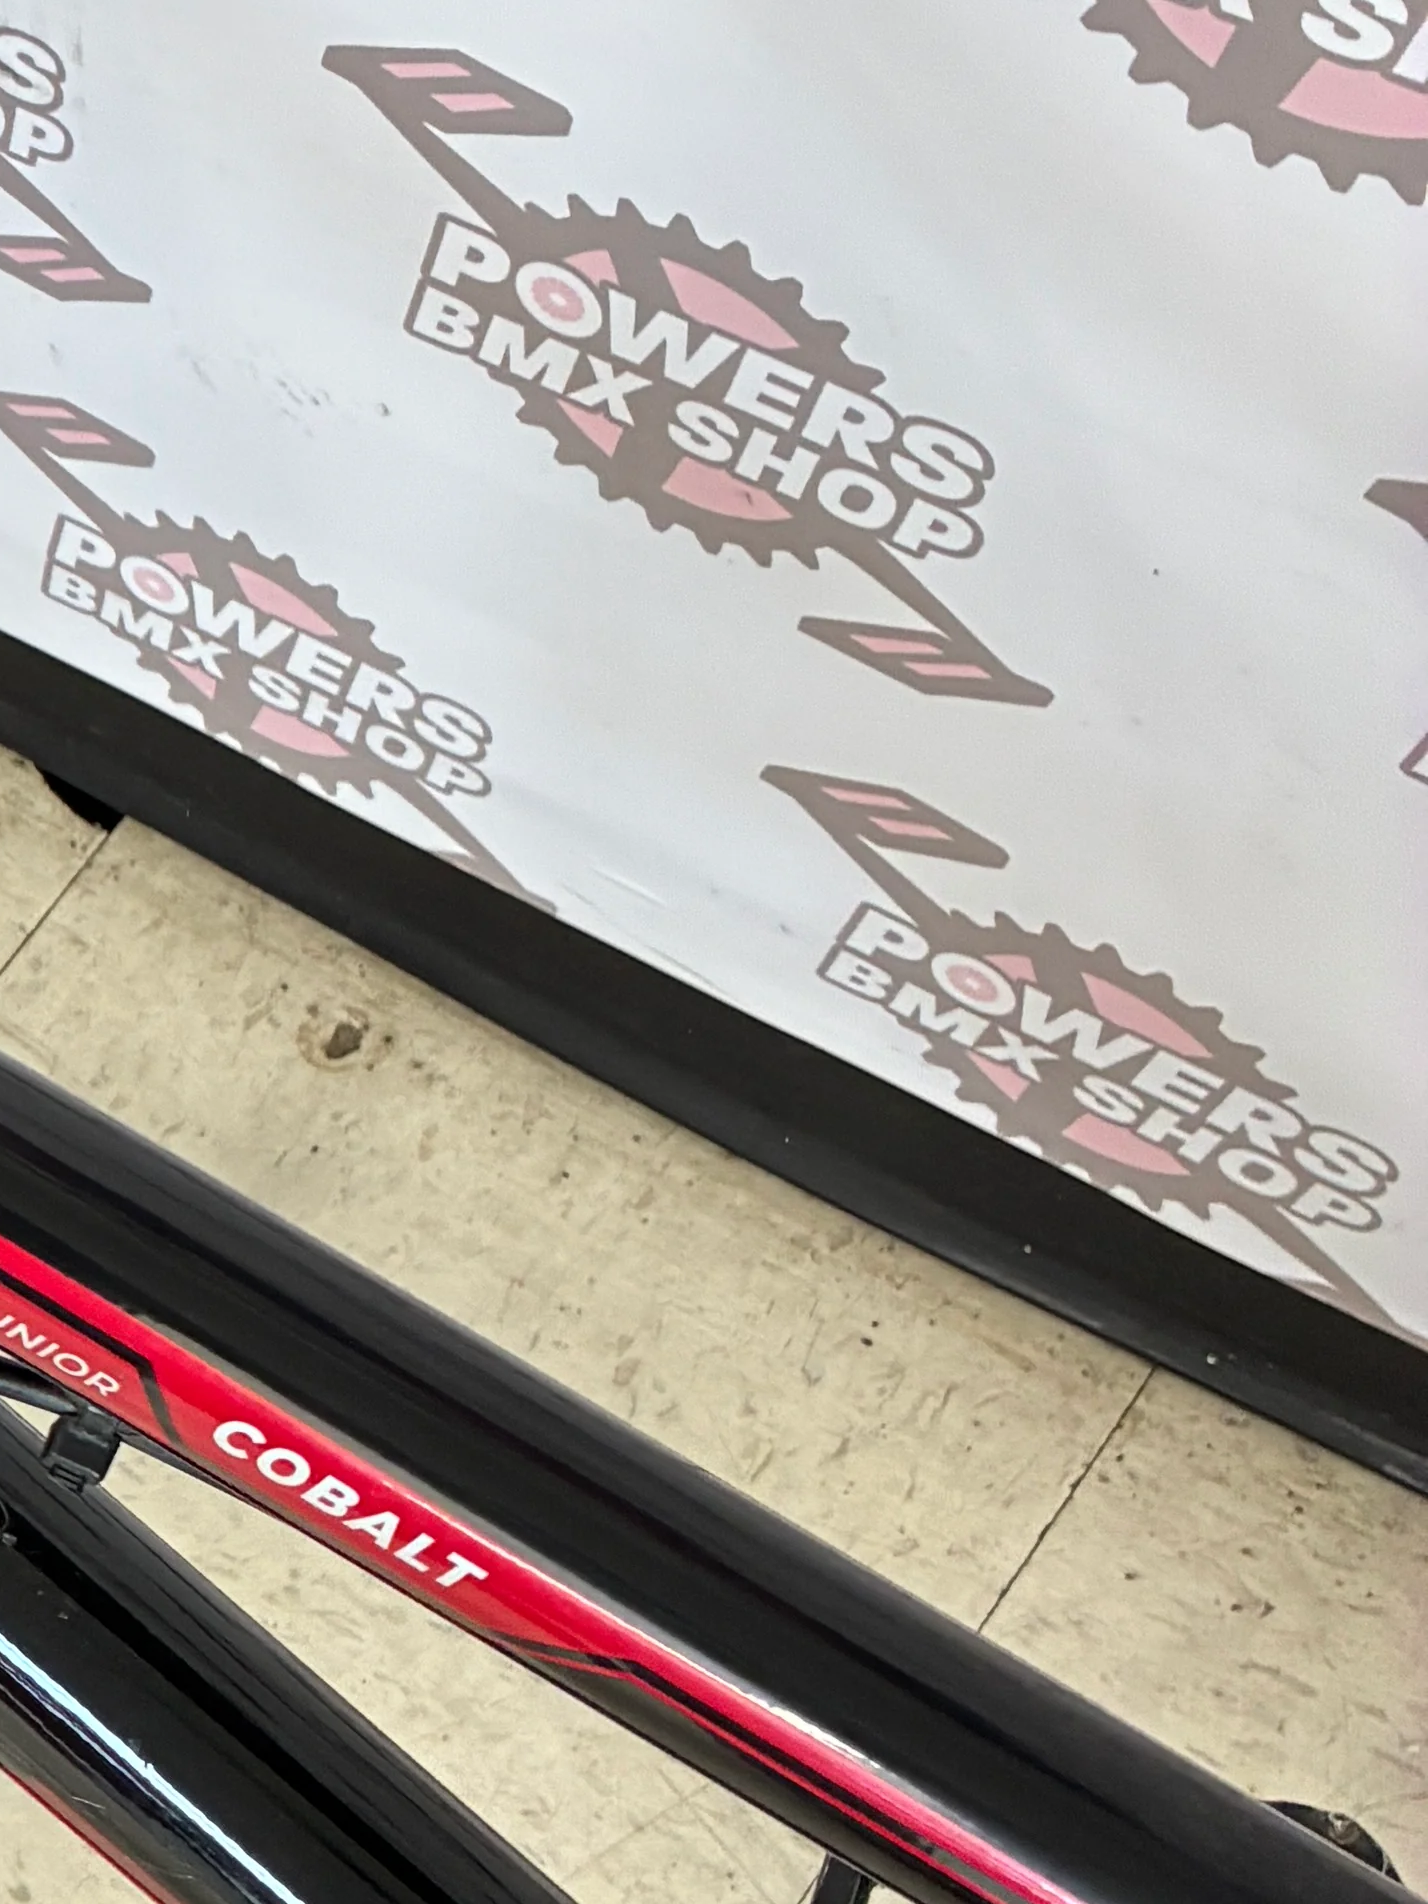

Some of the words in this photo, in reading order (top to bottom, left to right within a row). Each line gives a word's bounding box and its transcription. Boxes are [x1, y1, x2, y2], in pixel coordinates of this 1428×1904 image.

[410, 285, 653, 427] BMX
[667, 400, 978, 558] SHOP
[429, 222, 988, 501] POWERS
[49, 567, 233, 680] BMX
[247, 662, 487, 795] SHOP
[54, 521, 487, 756] POWERS
[824, 951, 1061, 1083] BMX
[1071, 1075, 1378, 1229] SHOP
[843, 908, 1390, 1197] POWERS
[211, 1419, 490, 1592] COBALT
